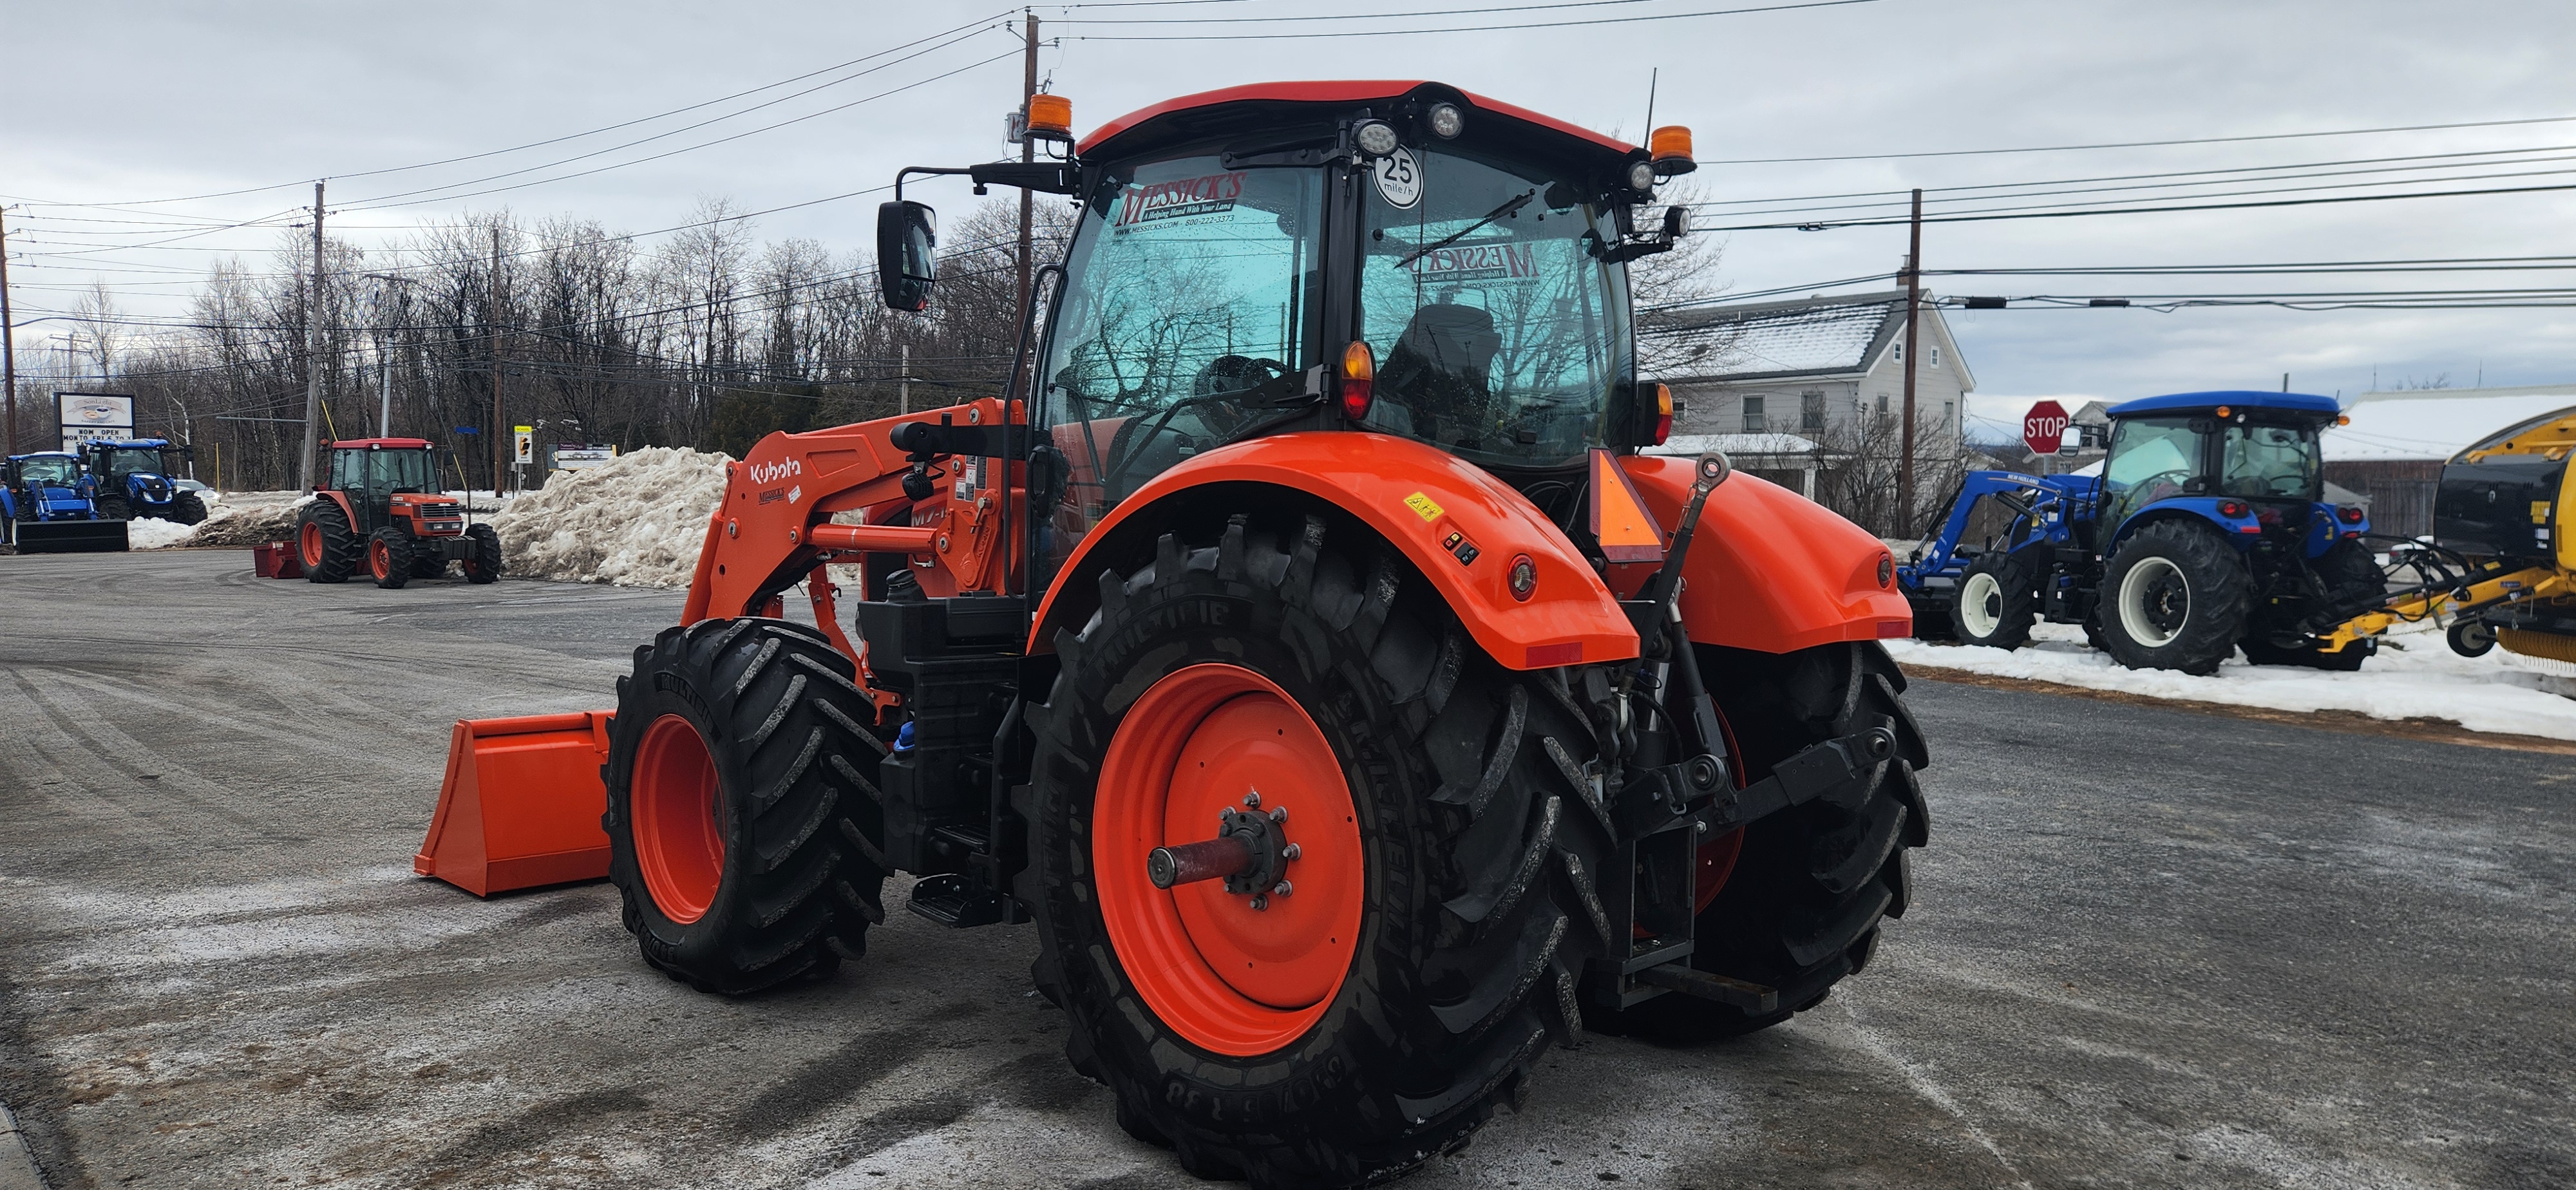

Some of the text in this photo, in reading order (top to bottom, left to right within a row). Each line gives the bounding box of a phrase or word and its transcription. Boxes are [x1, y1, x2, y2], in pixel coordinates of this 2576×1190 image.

[1383, 155, 1412, 184] 25
[1115, 172, 1247, 227] MESSICK'S
[1384, 183, 1413, 196] mile/h
[1148, 210, 1169, 219] Helping
[1215, 202, 1232, 211] Land
[1113, 214, 1235, 236] WWW.MESSICKS.COM 800-222-3373
[2026, 417, 2066, 438] STOP
[750, 456, 801, 484] Kubota
[911, 505, 947, 527] M7-1
